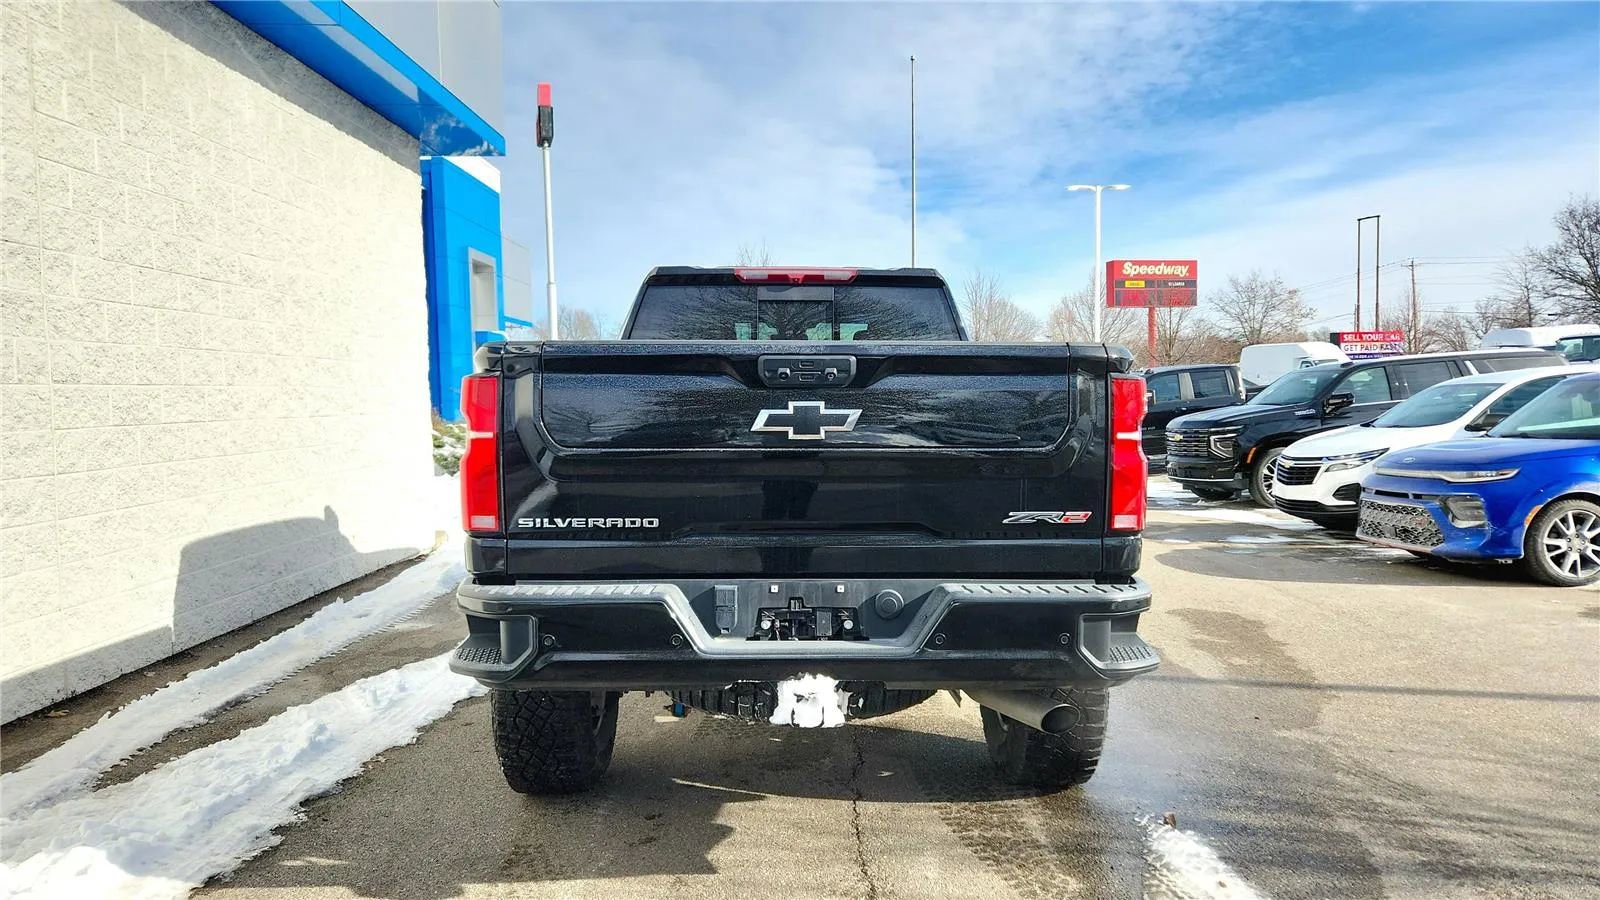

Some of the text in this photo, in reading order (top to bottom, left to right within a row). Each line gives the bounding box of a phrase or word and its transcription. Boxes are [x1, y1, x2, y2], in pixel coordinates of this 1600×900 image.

[1122, 261, 1189, 277] Speedway
[1343, 333, 1360, 341] SELL
[1361, 333, 1383, 341] YOUR
[1343, 344, 1358, 352] GET
[517, 517, 660, 529] SILVERADO
[1002, 511, 1093, 524] ZR2
